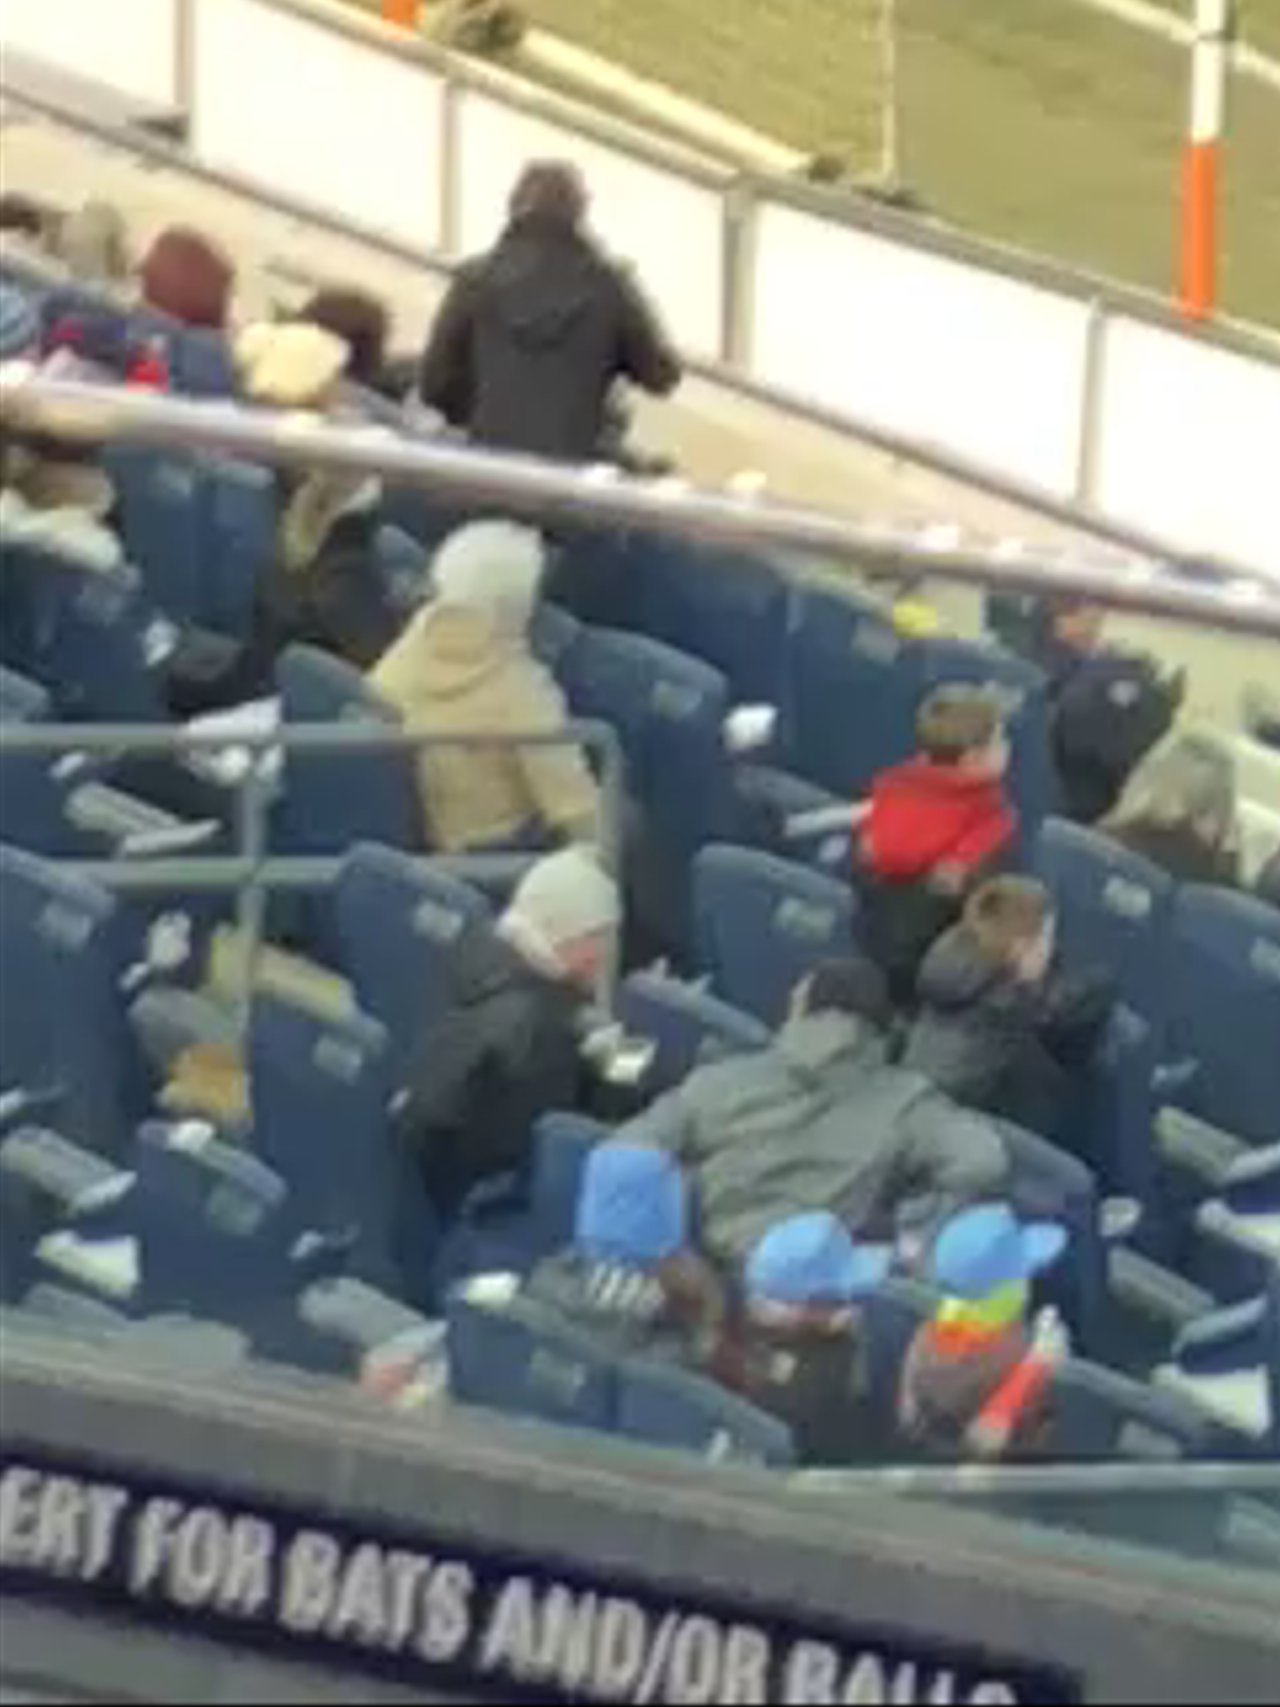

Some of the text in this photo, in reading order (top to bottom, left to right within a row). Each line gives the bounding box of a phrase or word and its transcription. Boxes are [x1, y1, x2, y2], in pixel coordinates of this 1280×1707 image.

[128, 1497, 274, 1617] FOR
[281, 1530, 473, 1664] BATS
[482, 1575, 769, 1705] AND/OR
